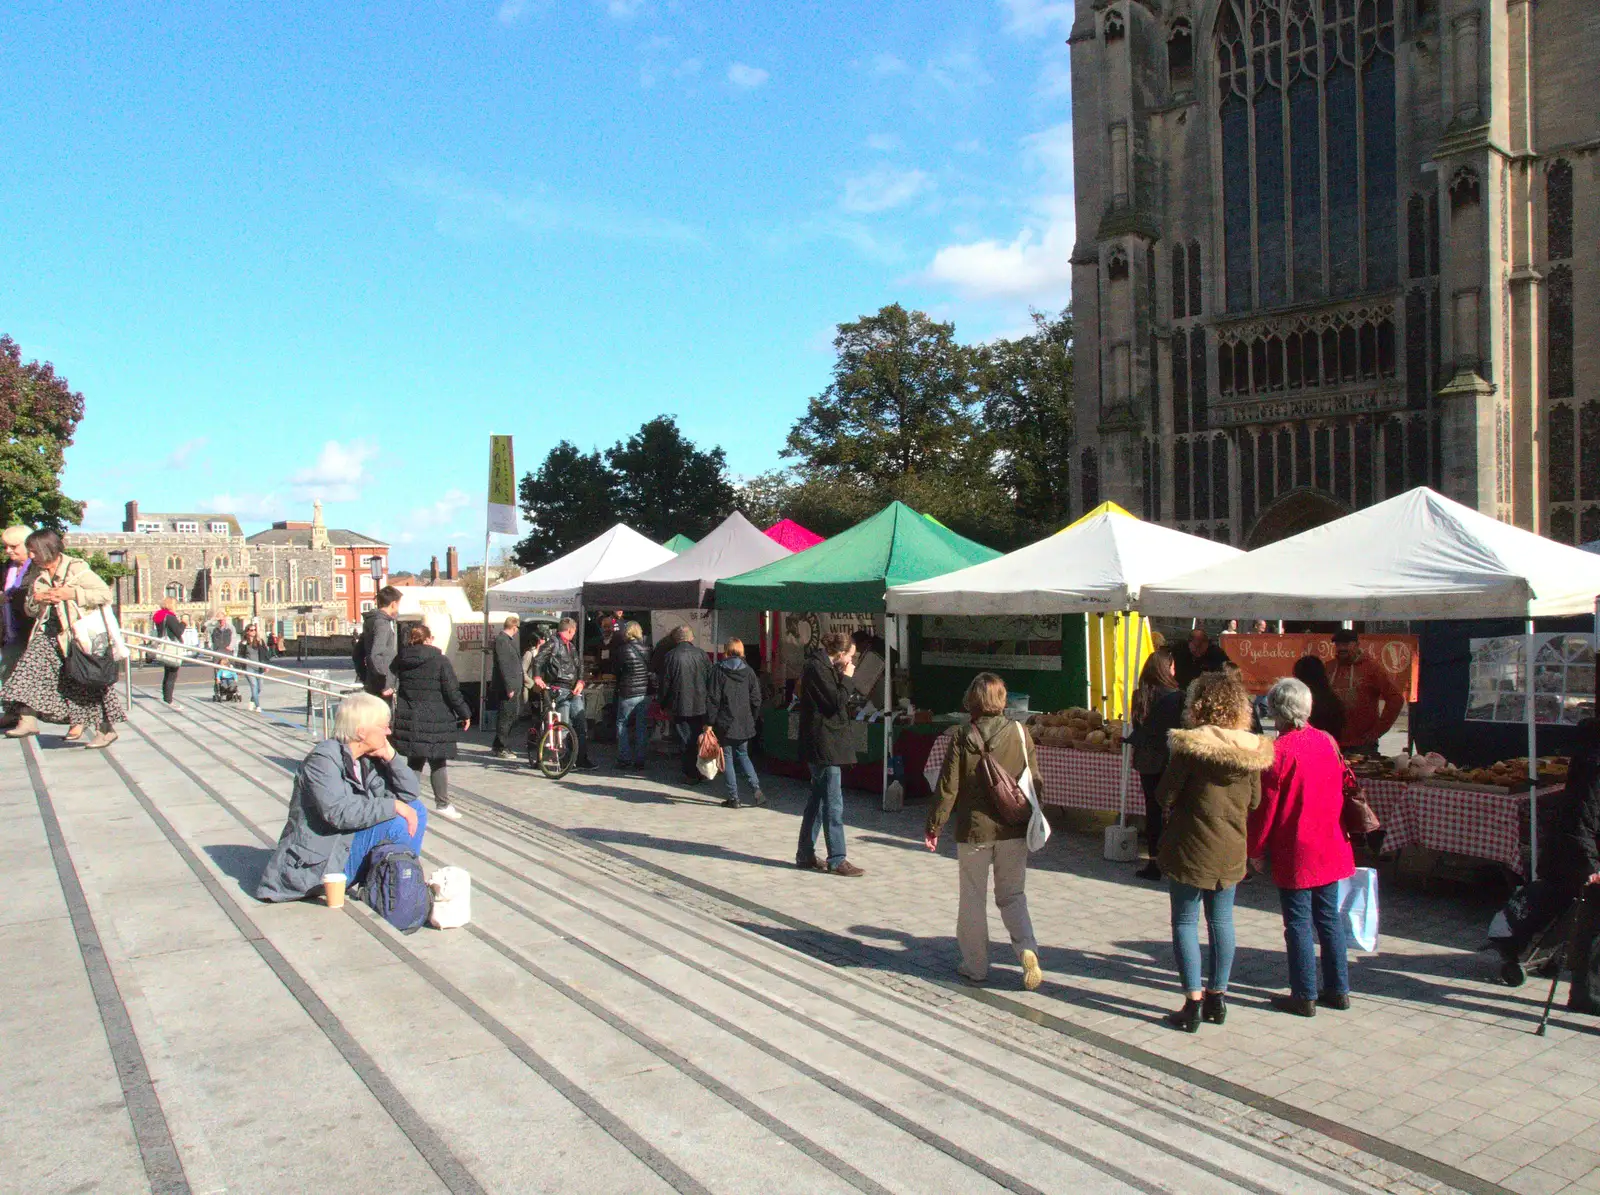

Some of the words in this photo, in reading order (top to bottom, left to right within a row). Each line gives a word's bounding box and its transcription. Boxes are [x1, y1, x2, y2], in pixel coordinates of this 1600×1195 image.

[456, 624, 496, 641] COFFE
[829, 623, 854, 635] WITH
[1239, 639, 1297, 665] Pyebaker
